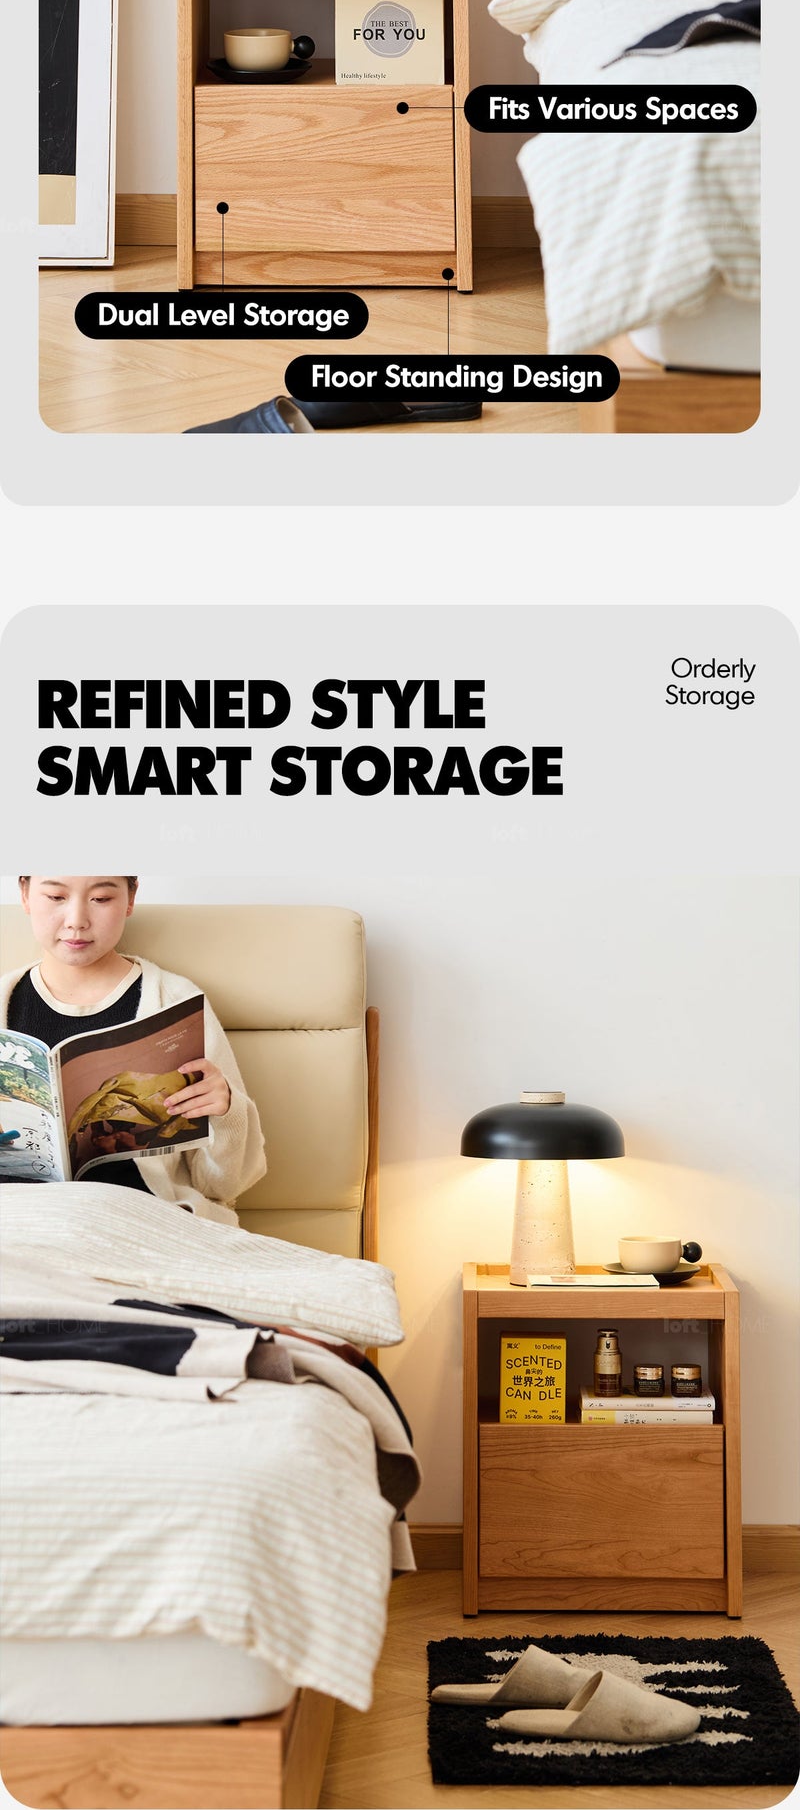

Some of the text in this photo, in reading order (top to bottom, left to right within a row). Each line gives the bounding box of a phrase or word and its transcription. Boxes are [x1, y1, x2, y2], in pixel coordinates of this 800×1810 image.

[353, 28, 426, 41] FOR YOU
[505, 1355, 562, 1370] SCENTED
[512, 1375, 555, 1387] 世界之旅
[505, 1387, 562, 1401] CAN DLE
